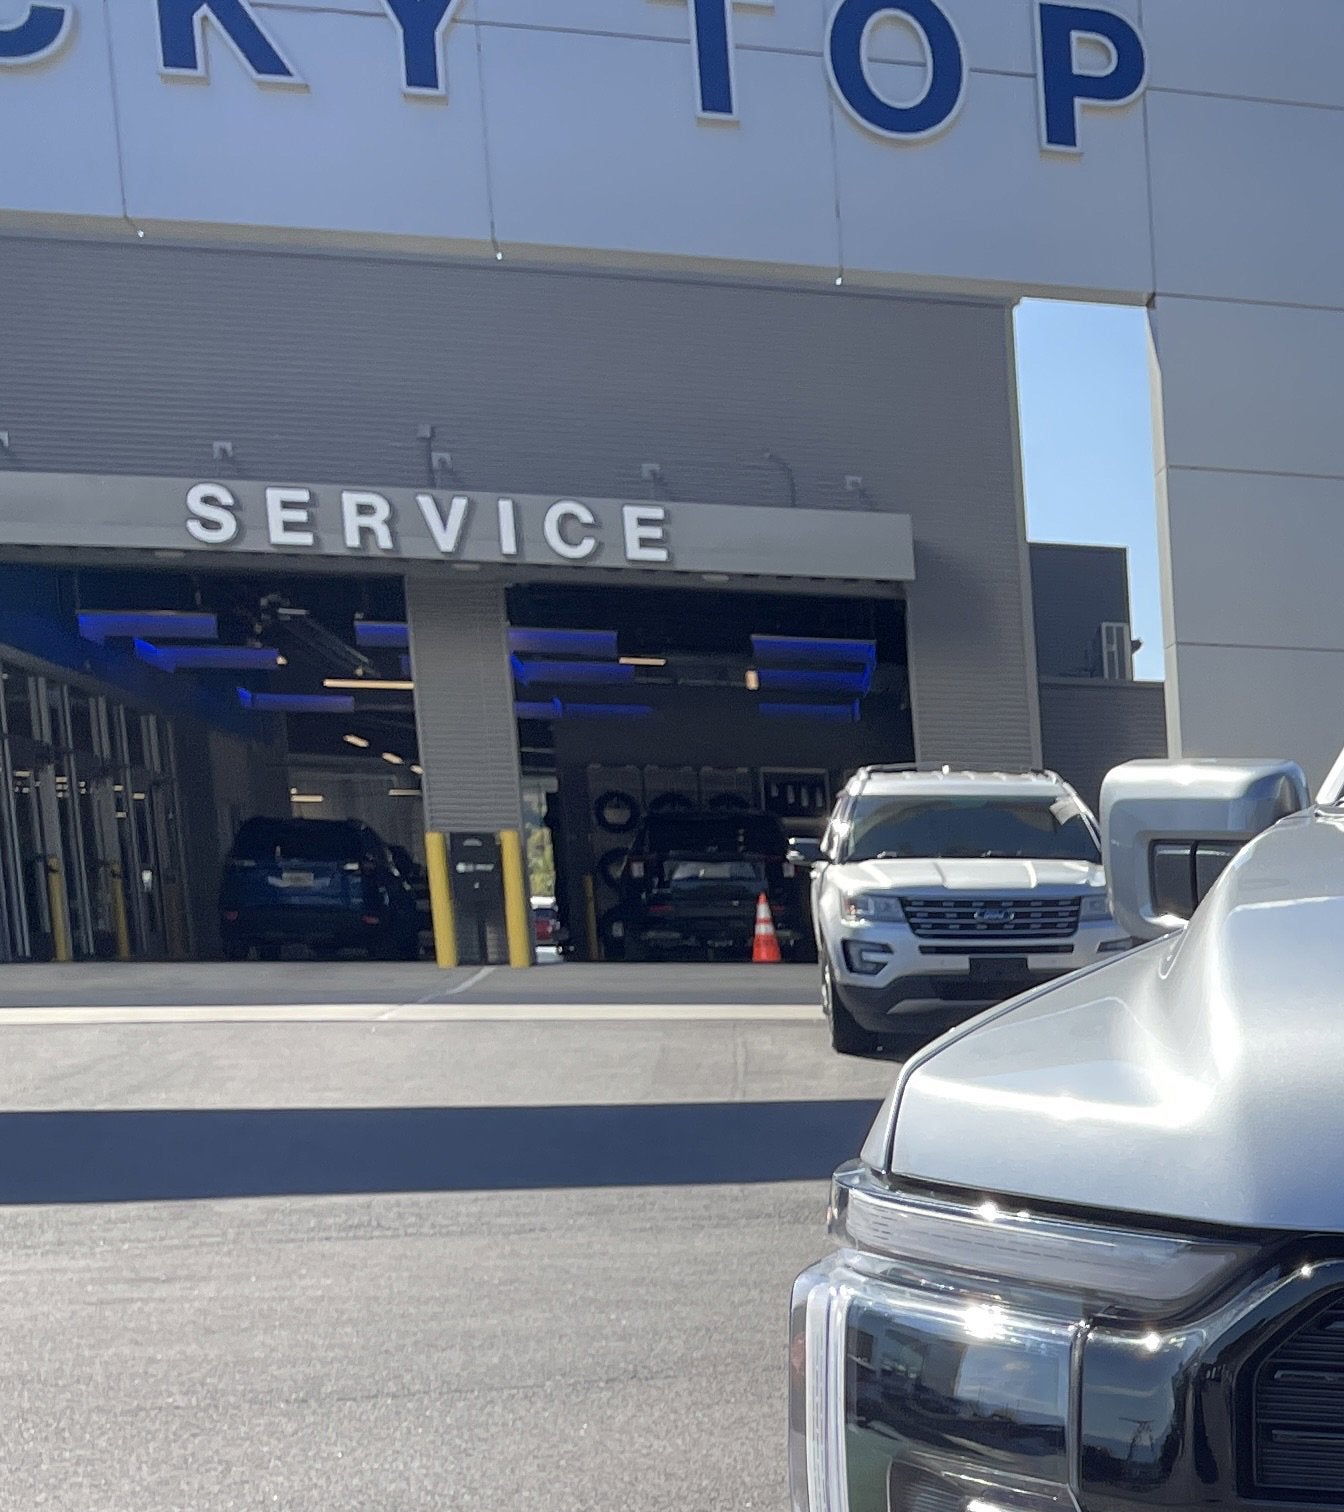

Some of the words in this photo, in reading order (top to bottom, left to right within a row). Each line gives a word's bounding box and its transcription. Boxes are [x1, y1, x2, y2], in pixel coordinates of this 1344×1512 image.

[0, 0, 460, 96] KY
[646, 0, 1147, 152] TOP
[186, 482, 669, 562] SERVICE
